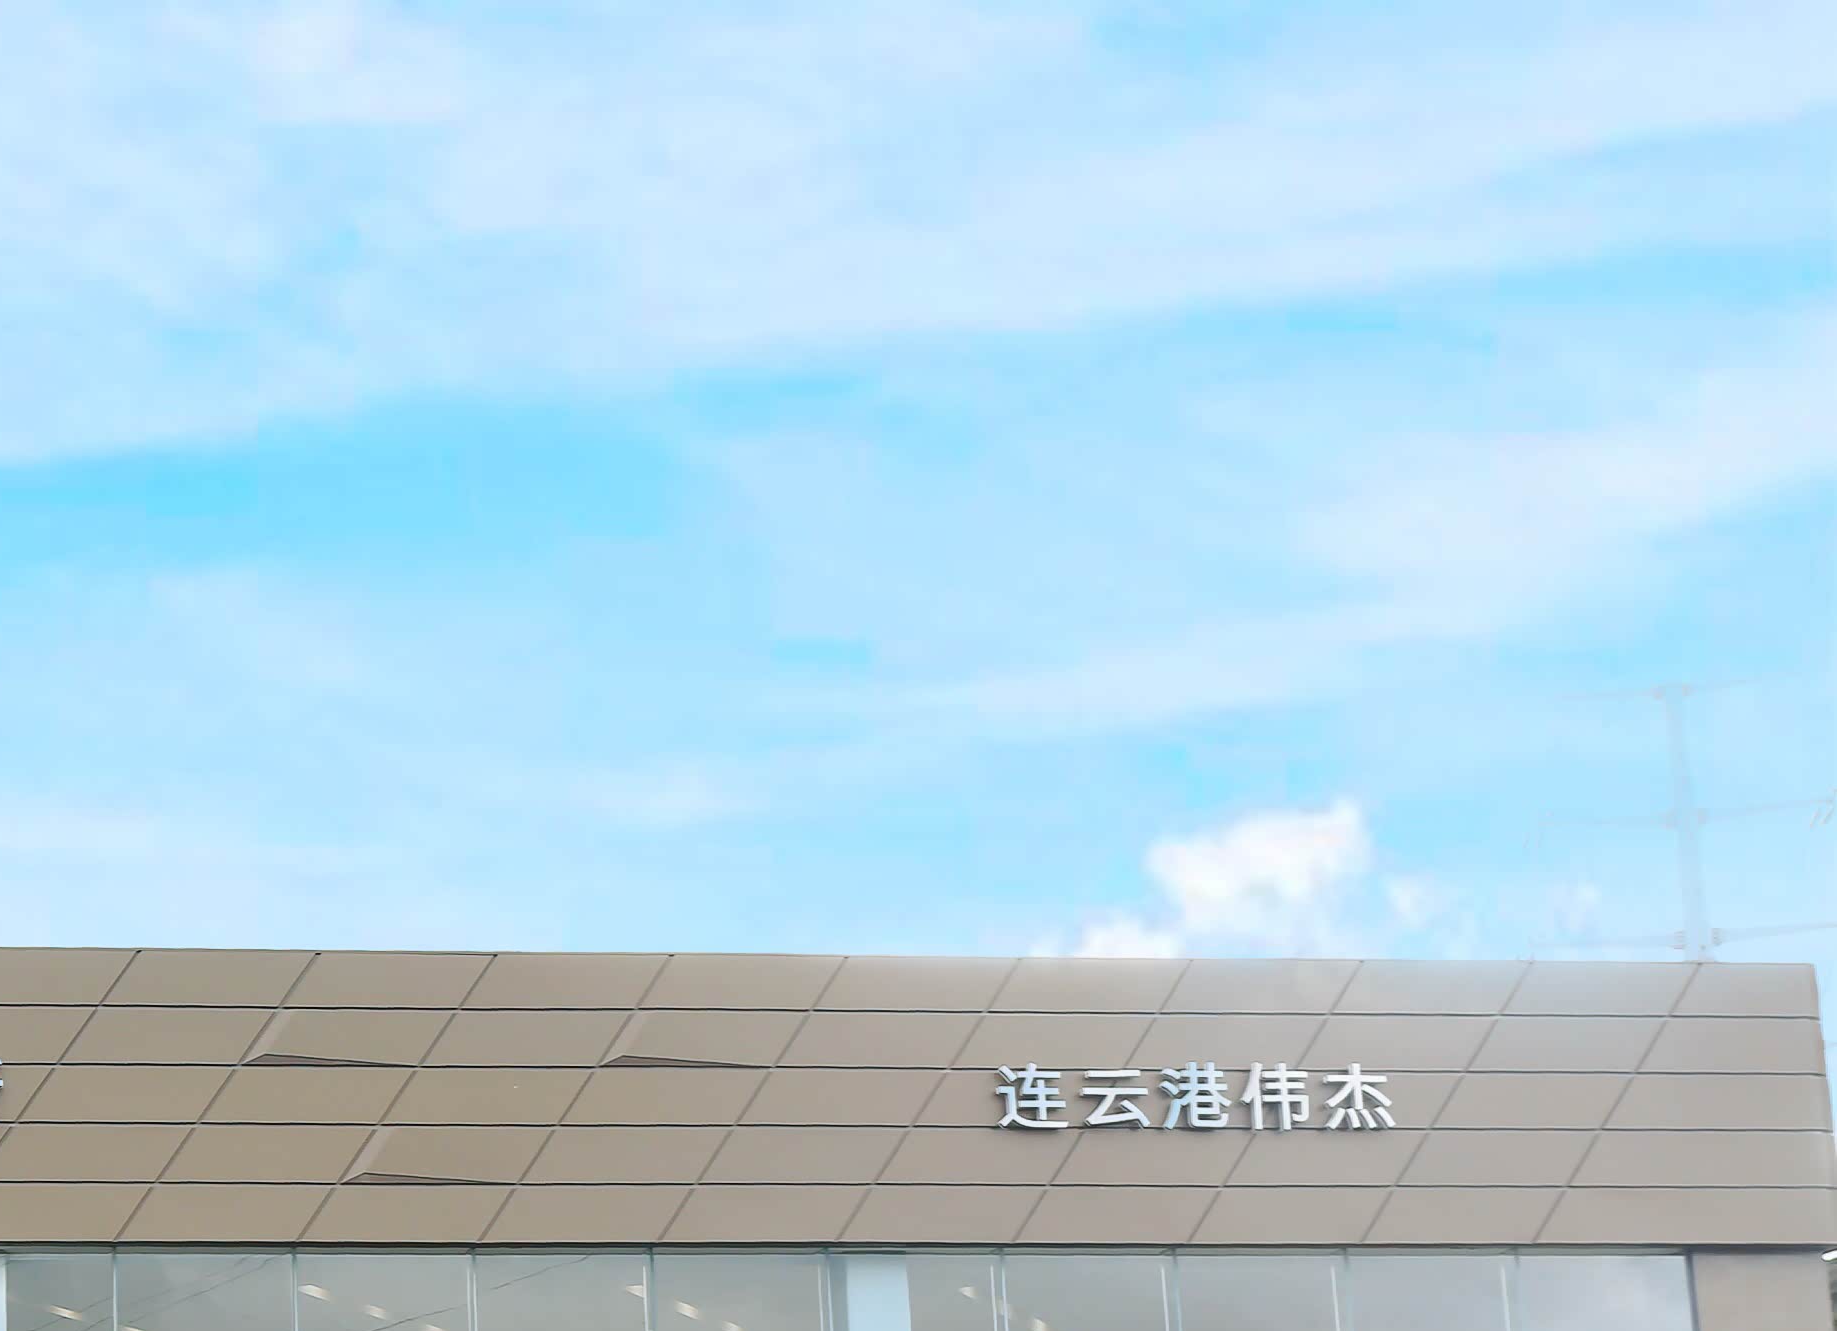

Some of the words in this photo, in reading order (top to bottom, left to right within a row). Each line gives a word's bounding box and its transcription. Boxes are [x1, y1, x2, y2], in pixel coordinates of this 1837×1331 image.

[995, 1061, 1396, 1131] 连云港伟杰
